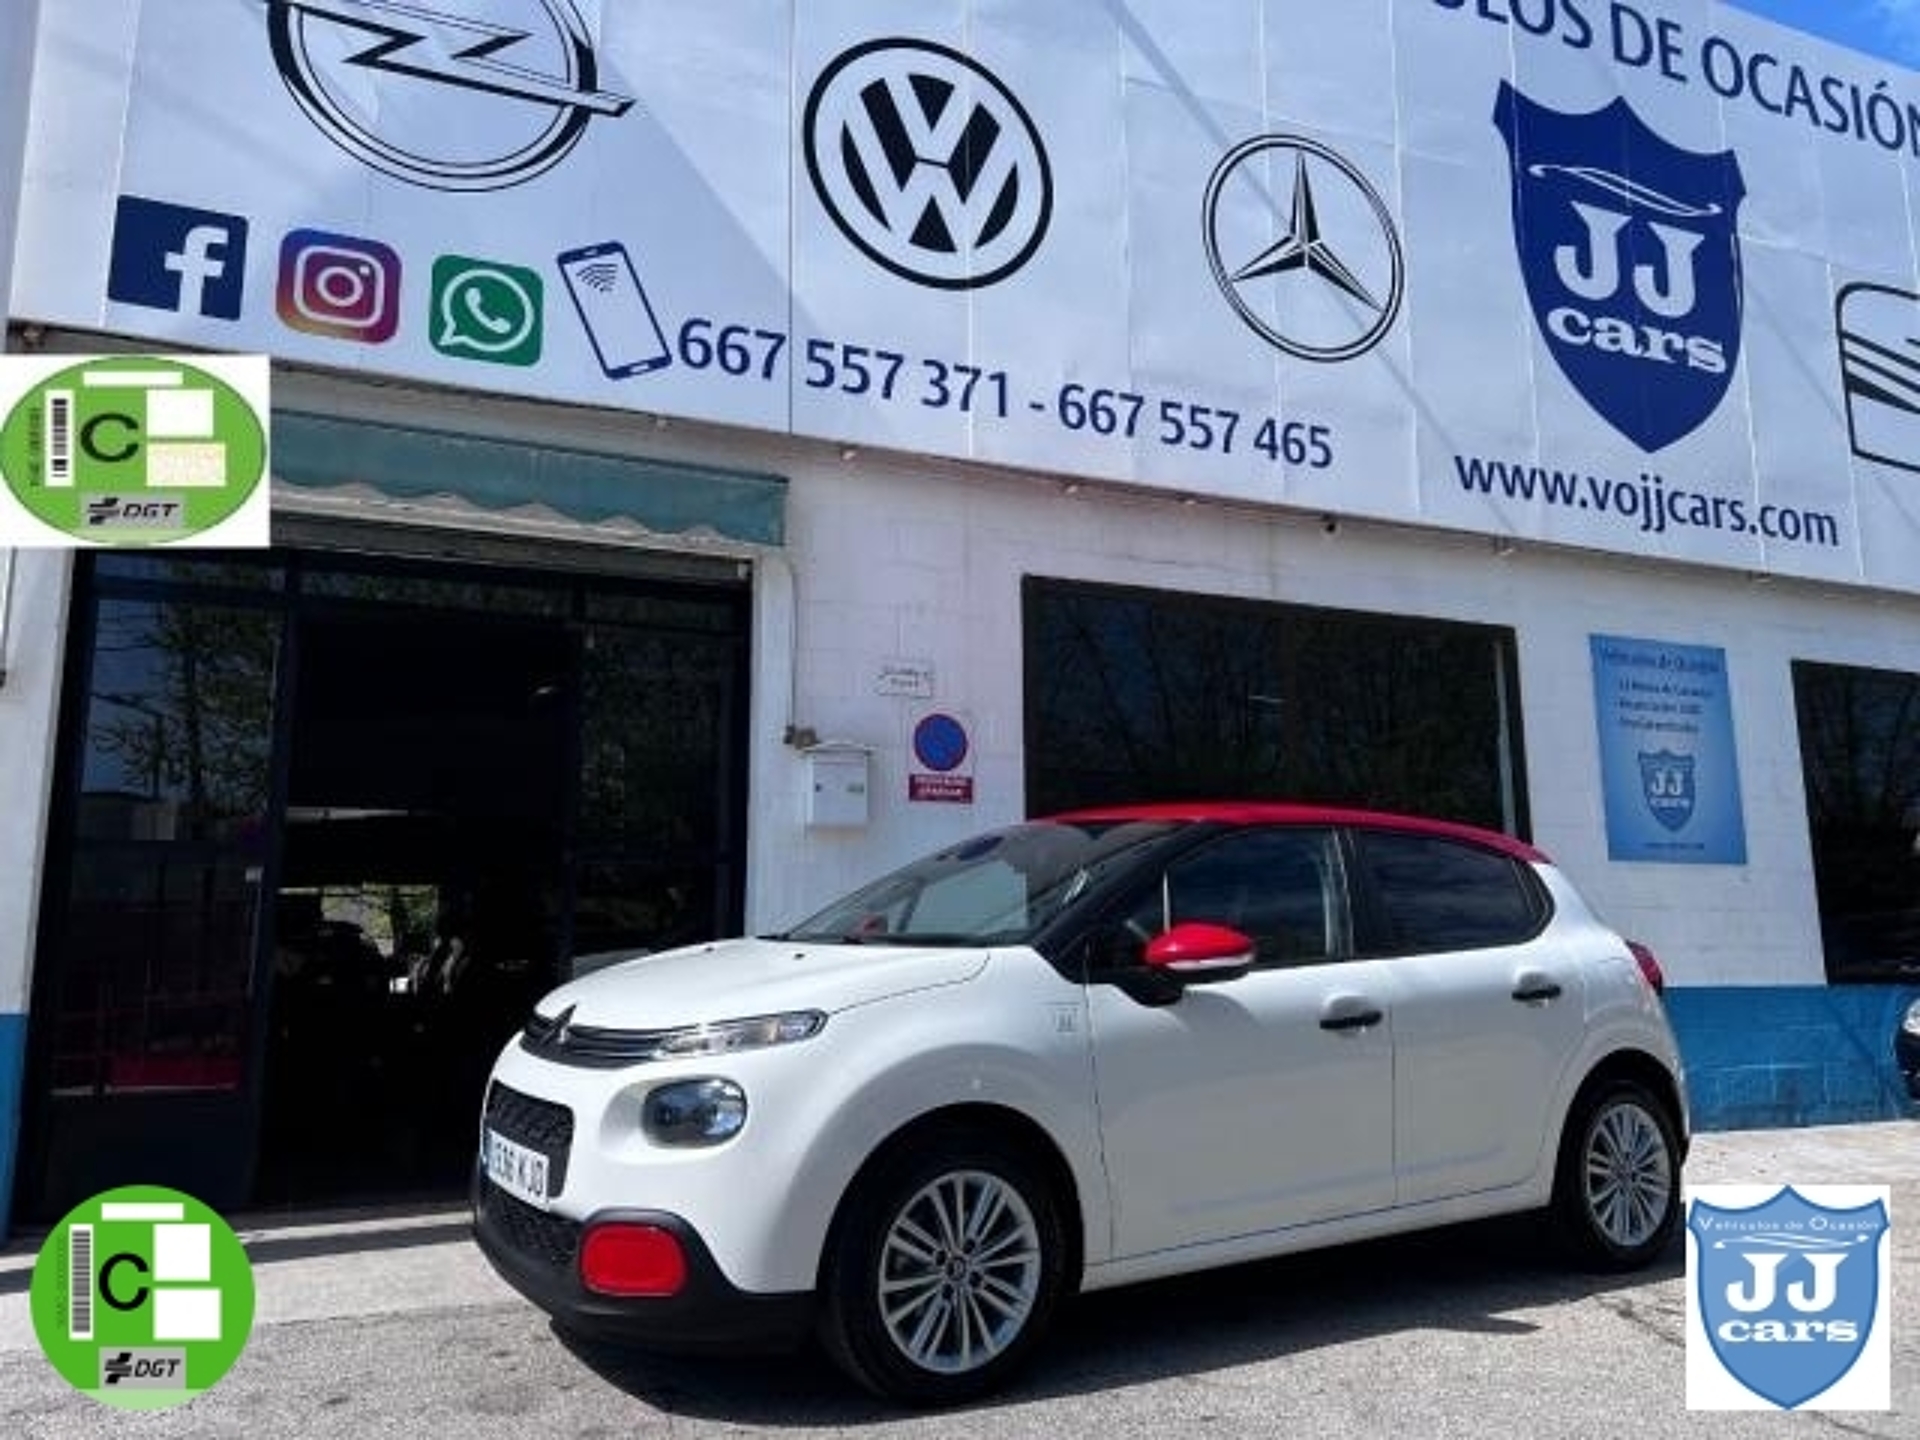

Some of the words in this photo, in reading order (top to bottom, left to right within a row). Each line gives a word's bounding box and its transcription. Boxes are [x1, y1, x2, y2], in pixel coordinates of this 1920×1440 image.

[1610, 3, 1688, 83] DE
[1554, 200, 1705, 318] JJ
[1547, 306, 1727, 374] cars
[677, 318, 787, 380] 667
[804, 339, 904, 400] 557
[920, 358, 1009, 418] 371
[1058, 383, 1145, 439] 667
[1158, 400, 1241, 454] 557
[1253, 417, 1332, 469] 465
[1455, 454, 1839, 547] www.vojjcars.com
